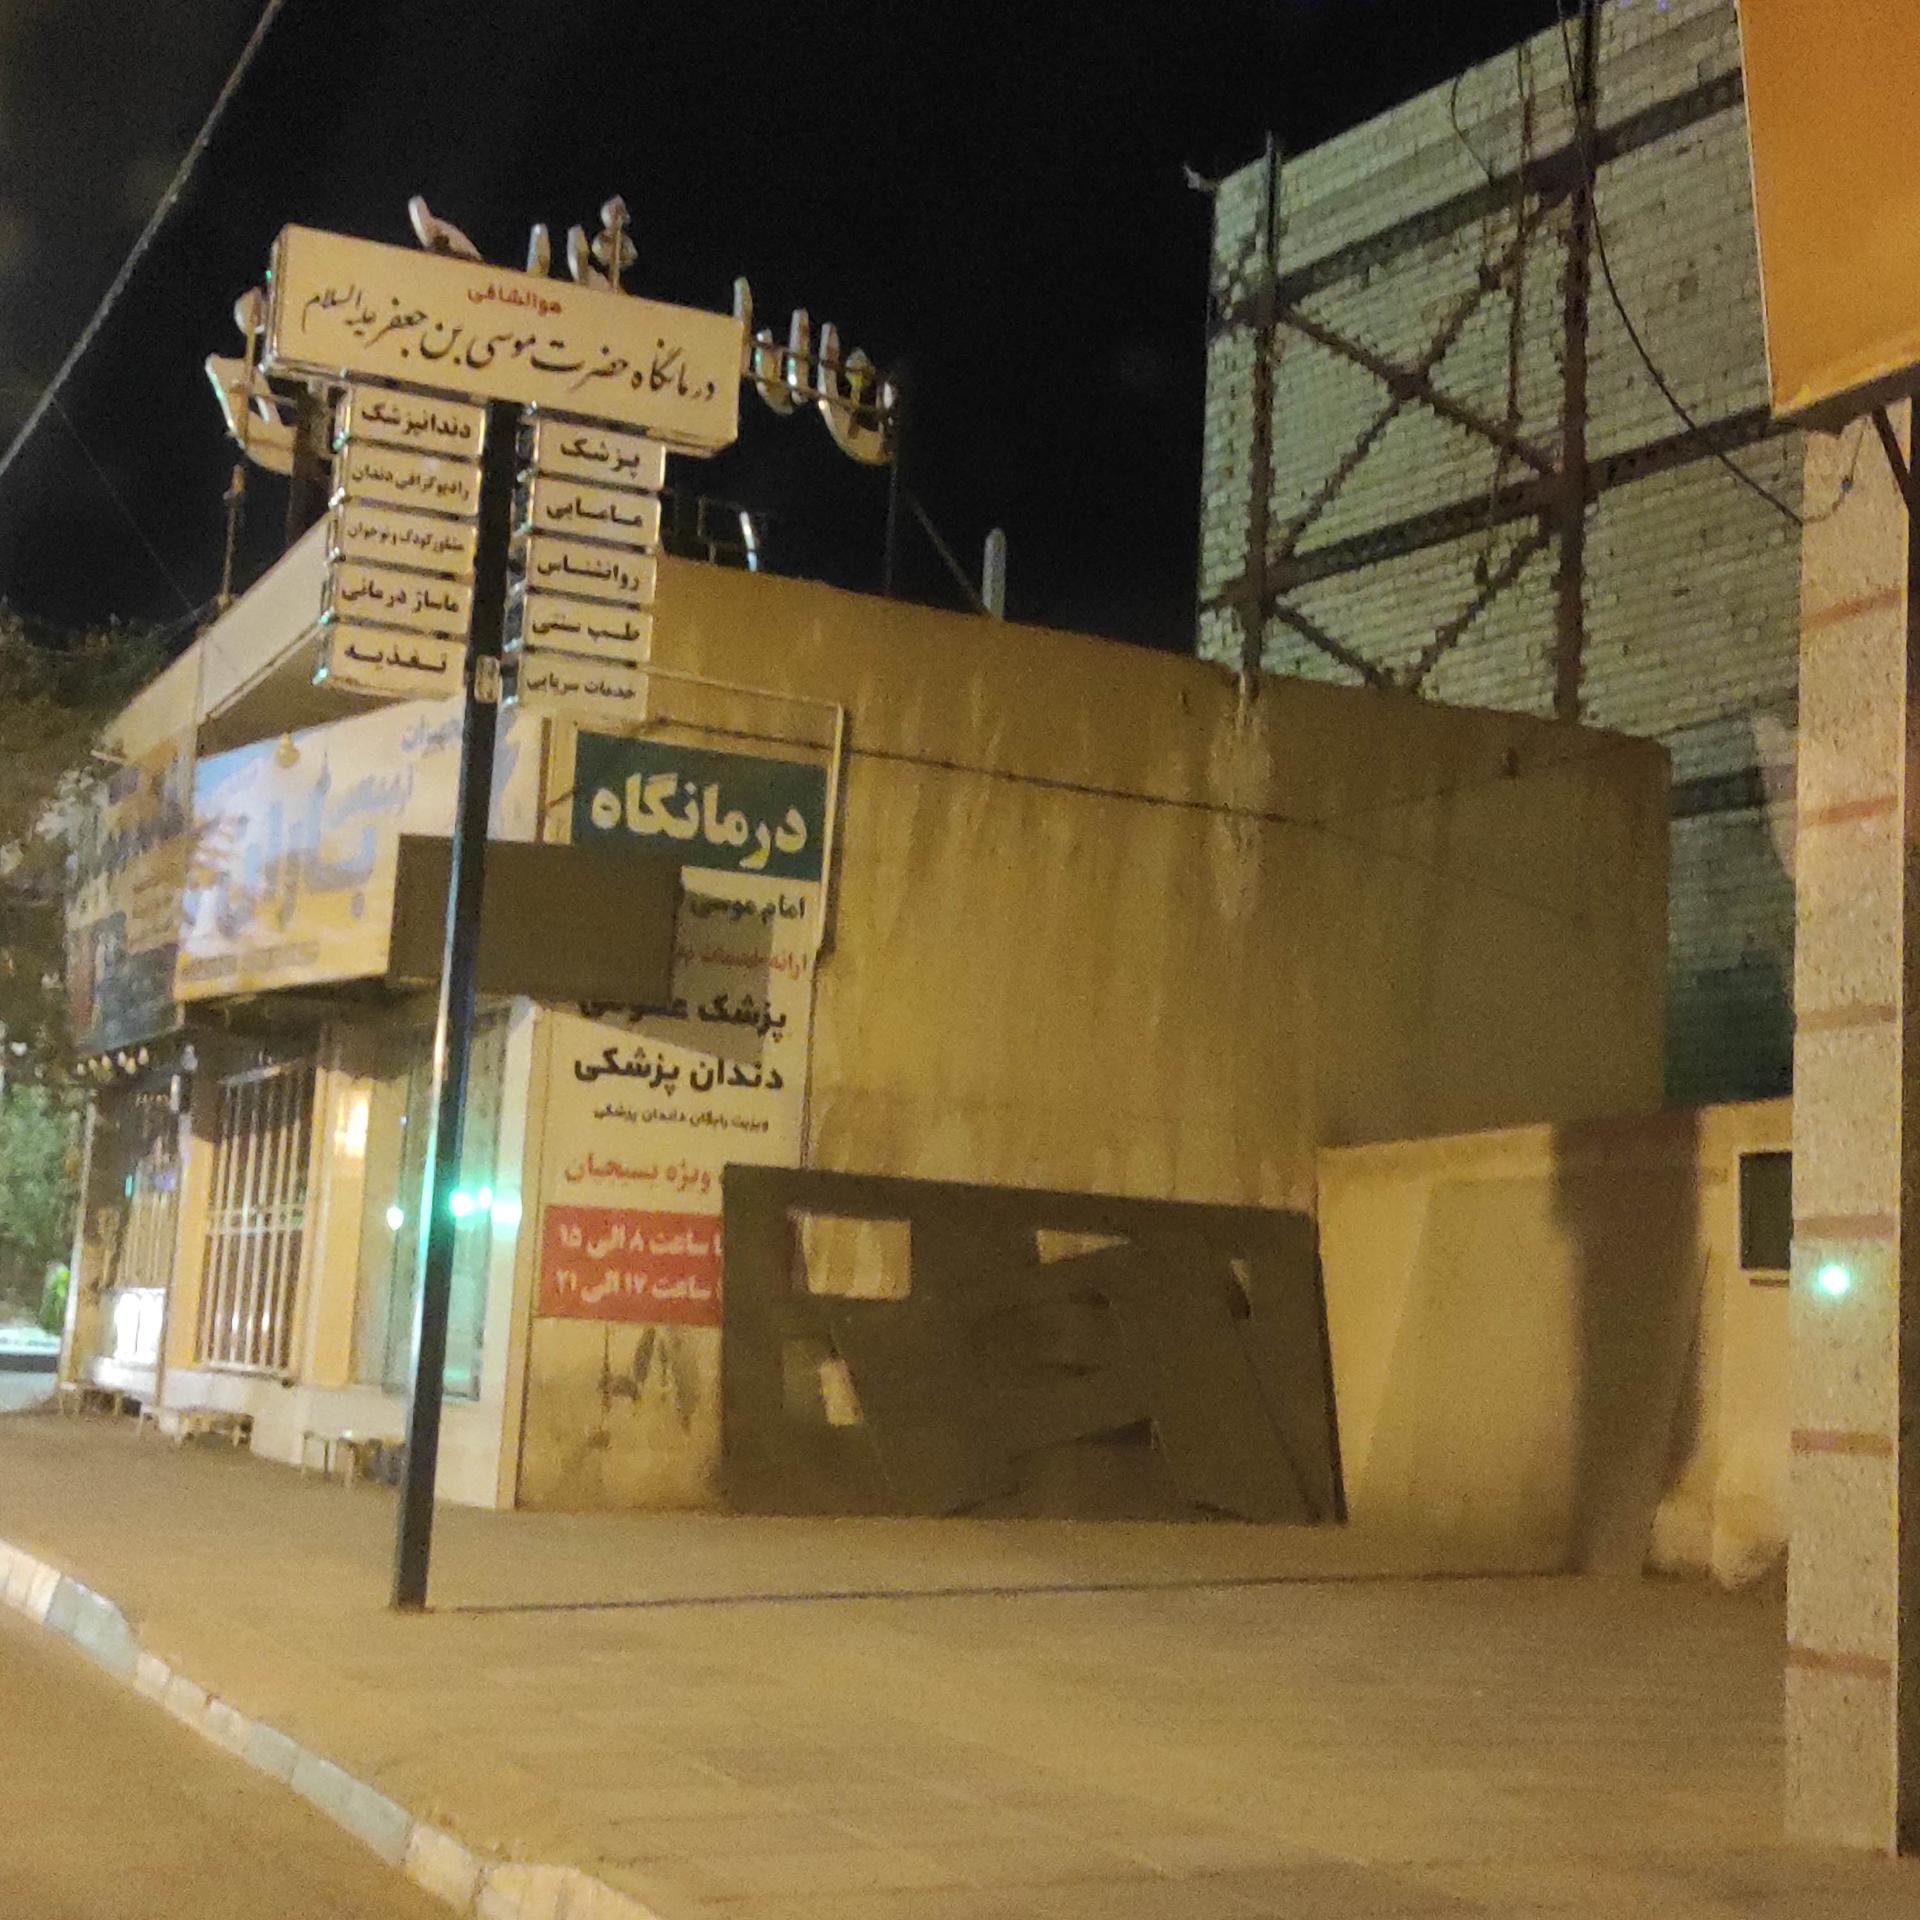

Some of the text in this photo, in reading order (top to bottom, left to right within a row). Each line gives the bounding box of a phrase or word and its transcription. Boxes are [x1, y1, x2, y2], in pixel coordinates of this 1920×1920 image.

[364, 296, 427, 358] جعفر
[420, 322, 463, 365] بن
[465, 331, 536, 369] موسی
[530, 338, 628, 394] حضرت
[631, 338, 715, 401] درمانگاه
[560, 438, 640, 479] پزشک
[411, 585, 460, 614] ماساژ
[532, 613, 641, 644] طب سنتی
[344, 644, 448, 673] تغذیه
[591, 772, 808, 870] درمانگاه
[761, 893, 806, 925] امام
[698, 992, 787, 1043] پزشک
[573, 1046, 784, 1097] دندان پزشکی
[665, 1158, 711, 1194] ویژه
[586, 1223, 627, 1260] الی
[649, 1228, 710, 1256] ساعت
[580, 1269, 621, 1303] الی
[651, 1274, 713, 1300] ساعت
